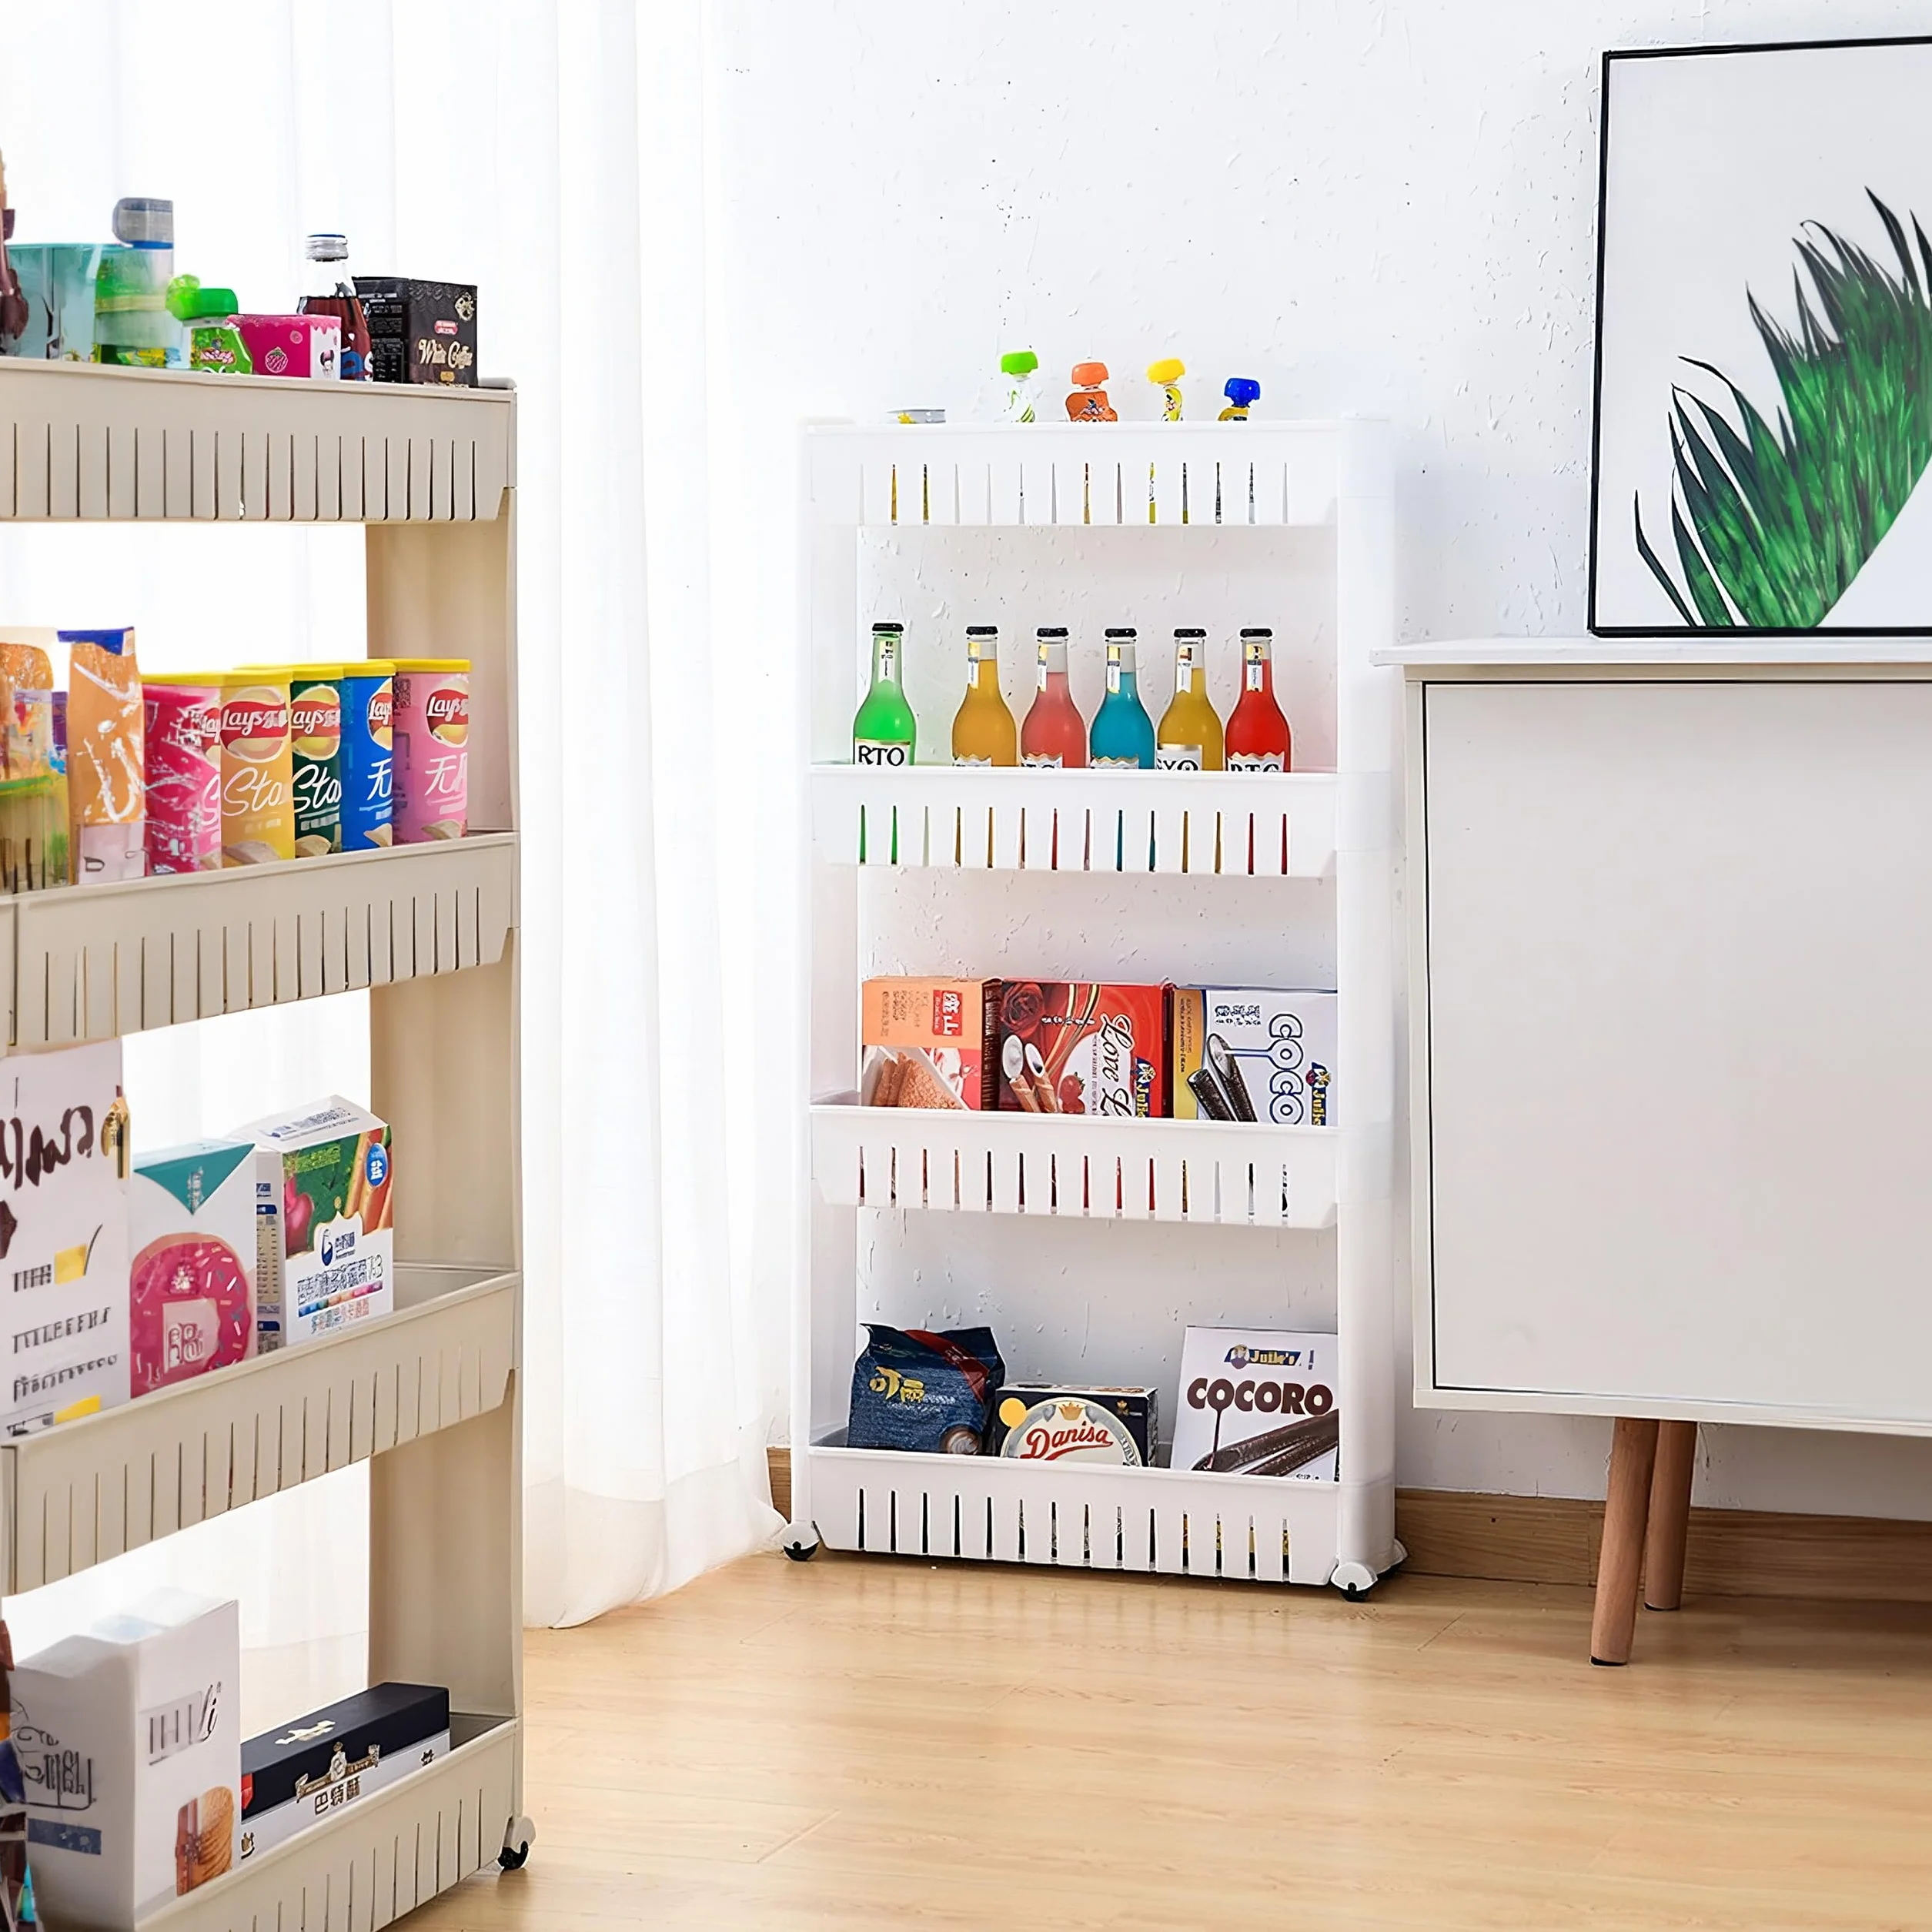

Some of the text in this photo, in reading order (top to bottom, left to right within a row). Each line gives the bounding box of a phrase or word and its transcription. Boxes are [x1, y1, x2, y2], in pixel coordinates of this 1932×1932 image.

[1100, 1014, 1134, 1117] Love L
[1269, 1013, 1304, 1125] COCO
[1186, 1377, 1333, 1417] COCORO
[1020, 1420, 1114, 1459] Danisa
